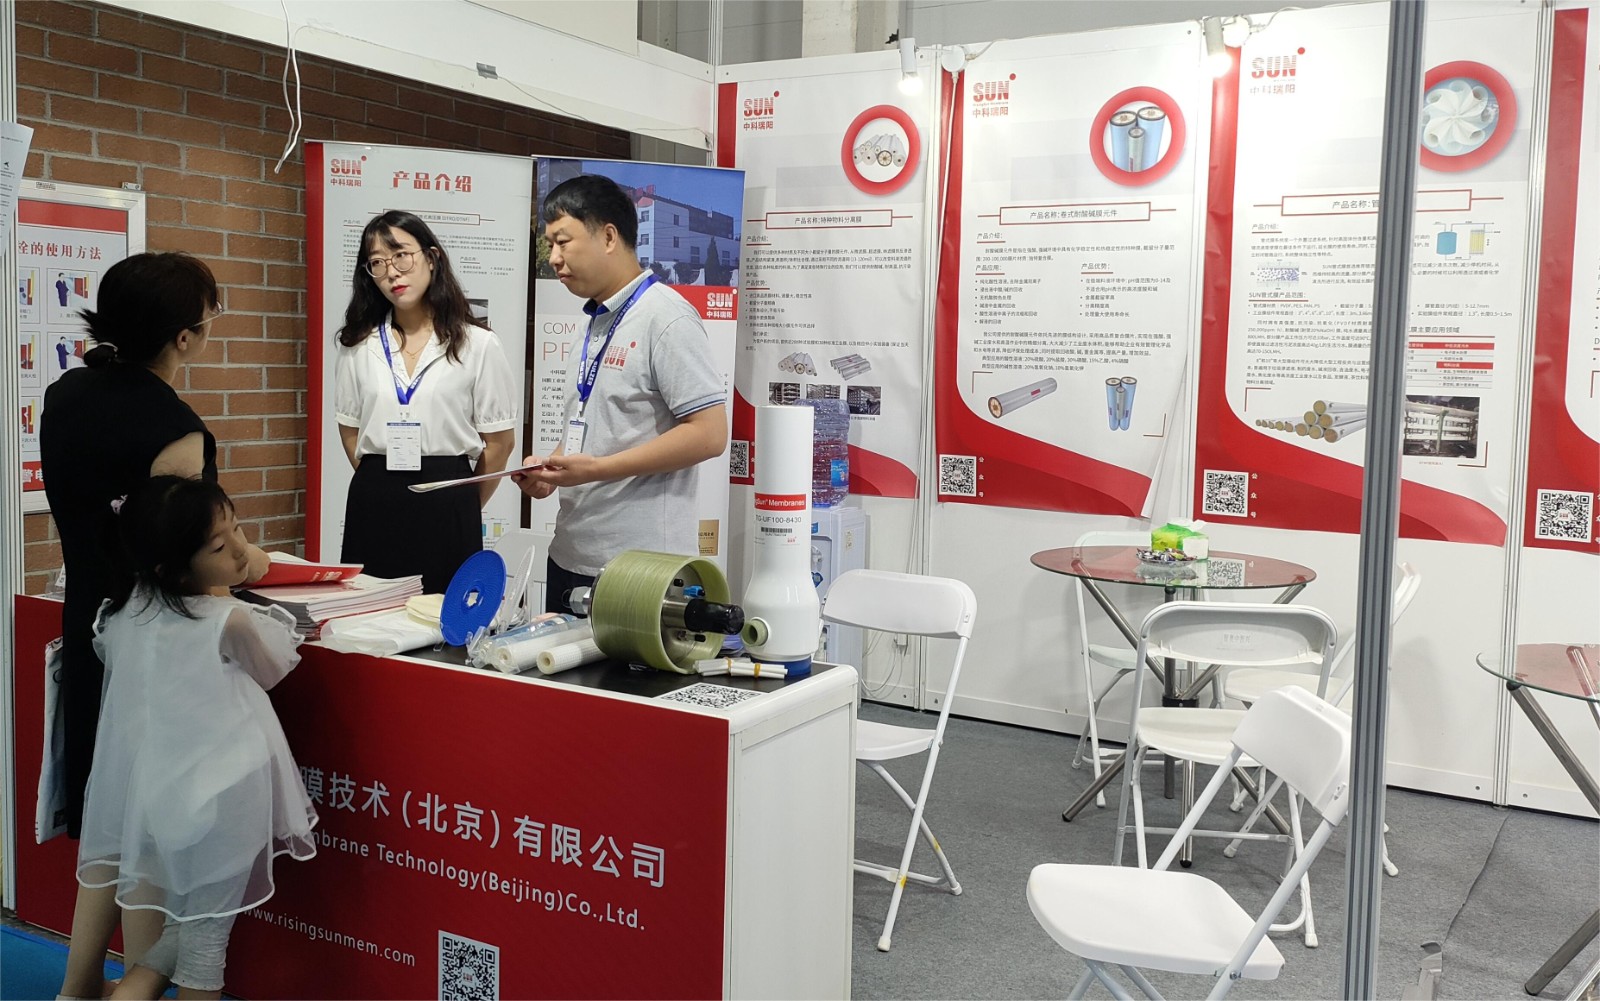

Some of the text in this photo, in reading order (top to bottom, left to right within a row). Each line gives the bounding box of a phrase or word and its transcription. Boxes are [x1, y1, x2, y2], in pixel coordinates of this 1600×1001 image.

[1251, 55, 1297, 78] SUN
[973, 81, 1010, 102] SUN
[743, 97, 774, 117] SUN
[972, 106, 1009, 118] 中科瑞阳
[743, 121, 774, 131] 中科瑞阳
[330, 158, 362, 175] SUN
[330, 178, 362, 187] 中科瑞阳
[393, 170, 472, 193] 产品介绍
[706, 292, 733, 308] SUN
[706, 310, 733, 319] 中科瑞阳
[769, 499, 805, 507] Membranes
[311, 828, 370, 857] mbrane
